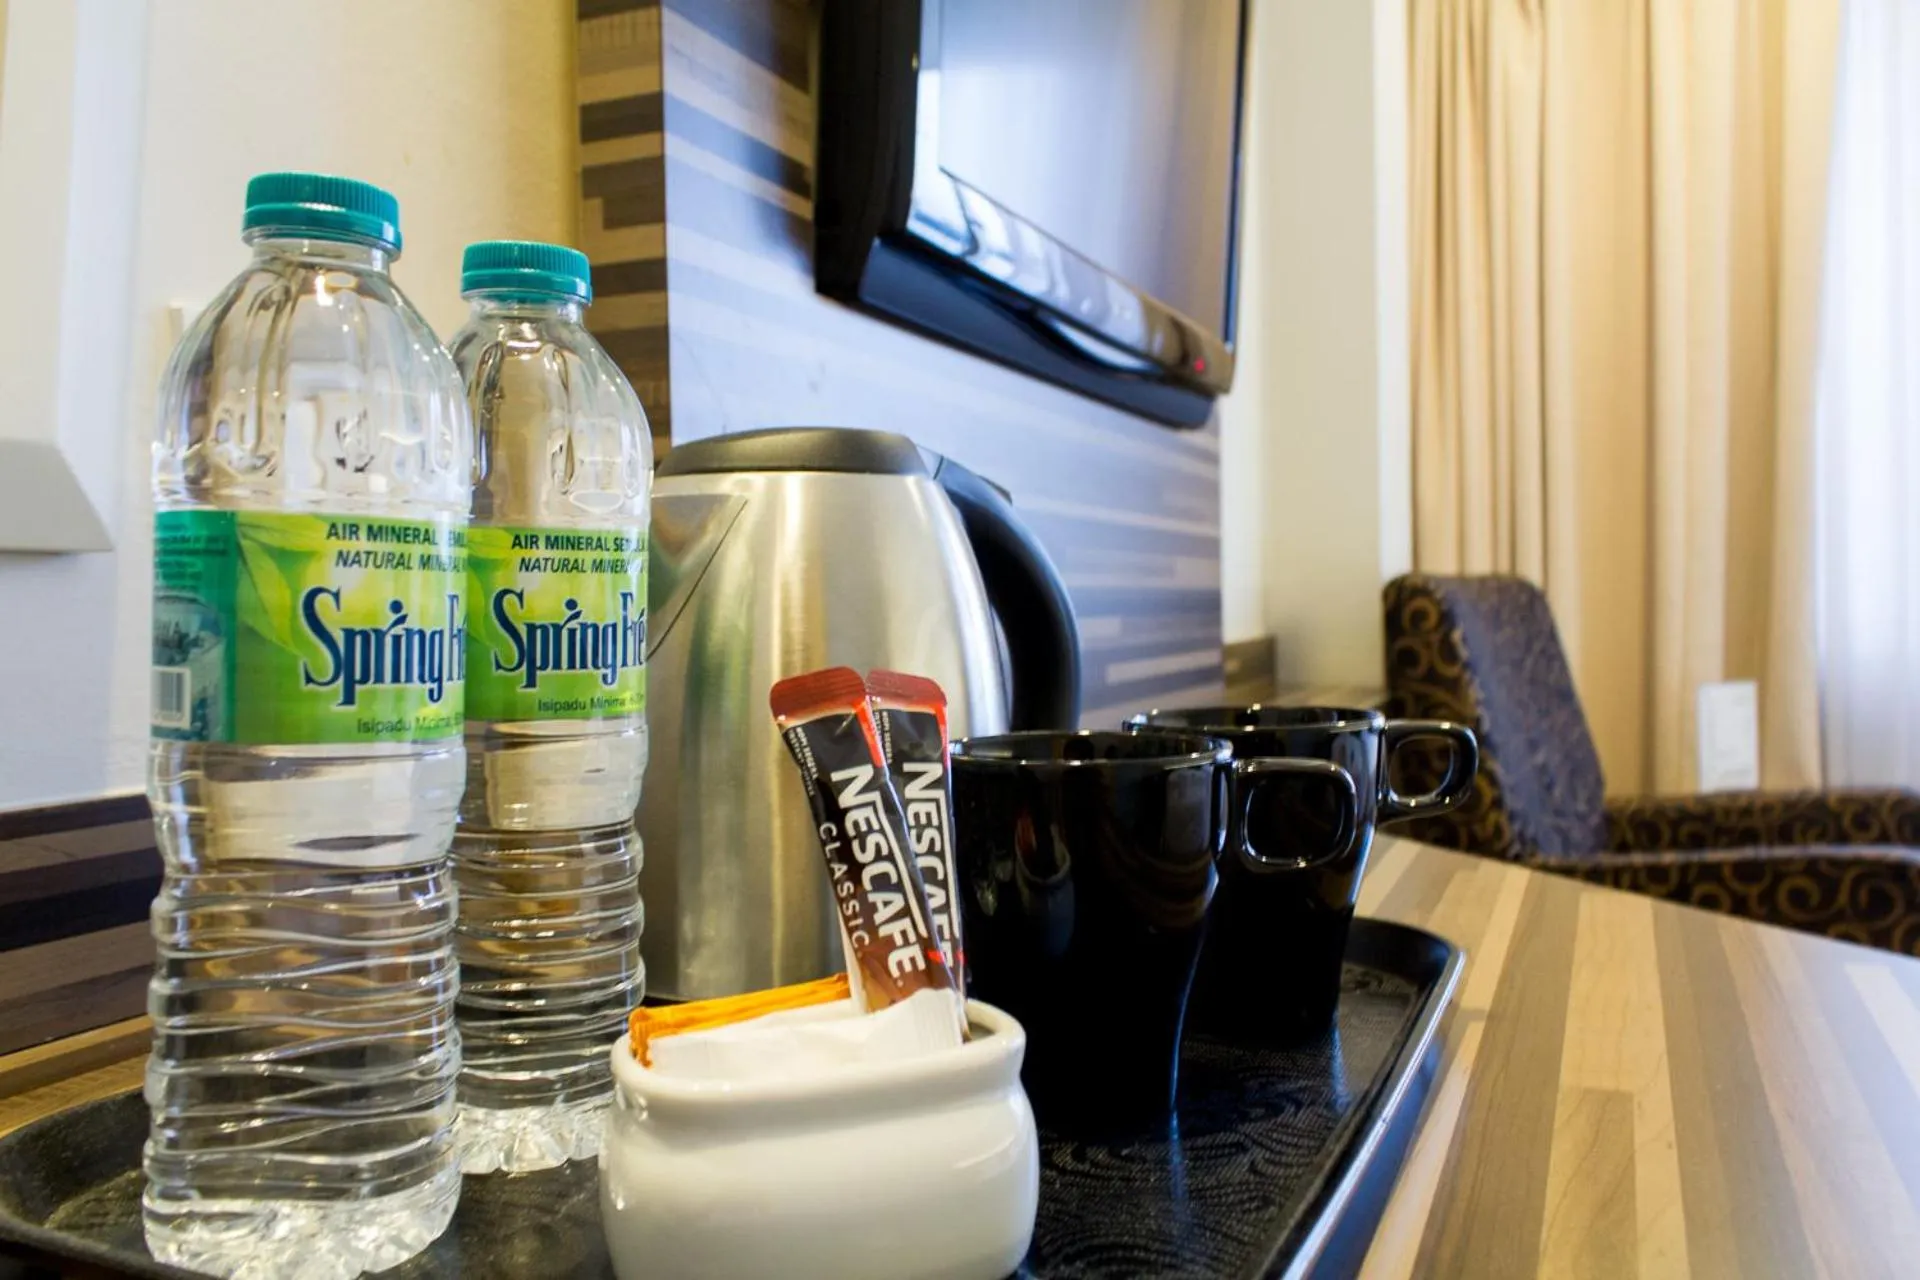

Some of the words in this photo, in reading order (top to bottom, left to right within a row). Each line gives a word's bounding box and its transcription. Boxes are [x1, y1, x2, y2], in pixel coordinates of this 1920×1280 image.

[325, 522, 360, 542] AIR
[366, 524, 438, 546] MINERAL
[511, 533, 540, 551] AIR
[544, 535, 610, 553] MINERAL
[334, 549, 414, 572] NATURAL
[518, 557, 588, 573] NATURAL
[538, 697, 587, 714] Isipadu
[819, 821, 870, 948] CLASSIC
